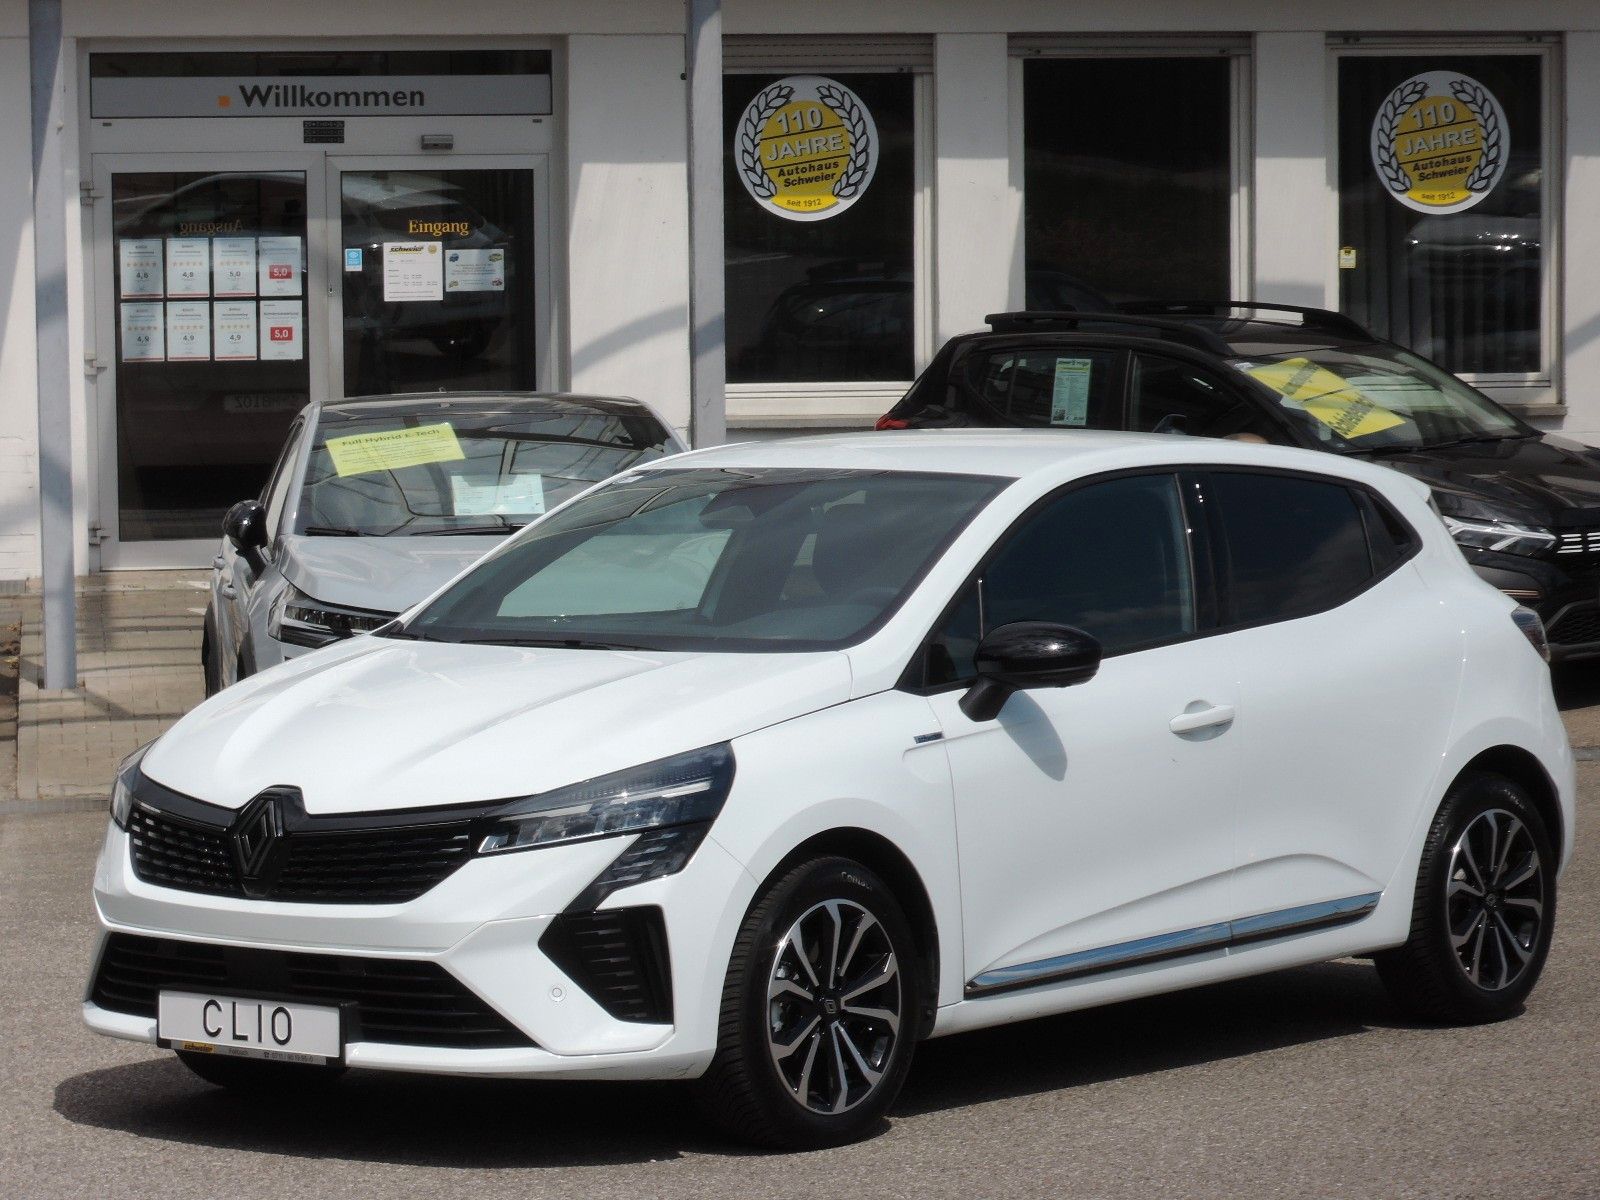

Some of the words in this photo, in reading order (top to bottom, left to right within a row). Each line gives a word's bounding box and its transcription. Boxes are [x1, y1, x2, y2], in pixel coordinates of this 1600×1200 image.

[239, 85, 425, 107] Willkommen
[778, 107, 823, 133] 110
[1412, 102, 1456, 128] 110
[768, 133, 845, 161] JAHRE
[1404, 128, 1477, 156] JAHRE
[778, 161, 840, 178] Autohaus
[1412, 155, 1472, 172] Autohaus
[784, 172, 837, 187] Schweier
[1418, 165, 1469, 181] Schweier
[804, 198, 822, 207] 1912
[1438, 192, 1456, 200] 1912
[409, 219, 470, 236] Eingang
[273, 268, 287, 277] 5,0
[230, 334, 241, 342] 4,9
[274, 329, 288, 339] 5,0
[203, 999, 292, 1046] CLIO
